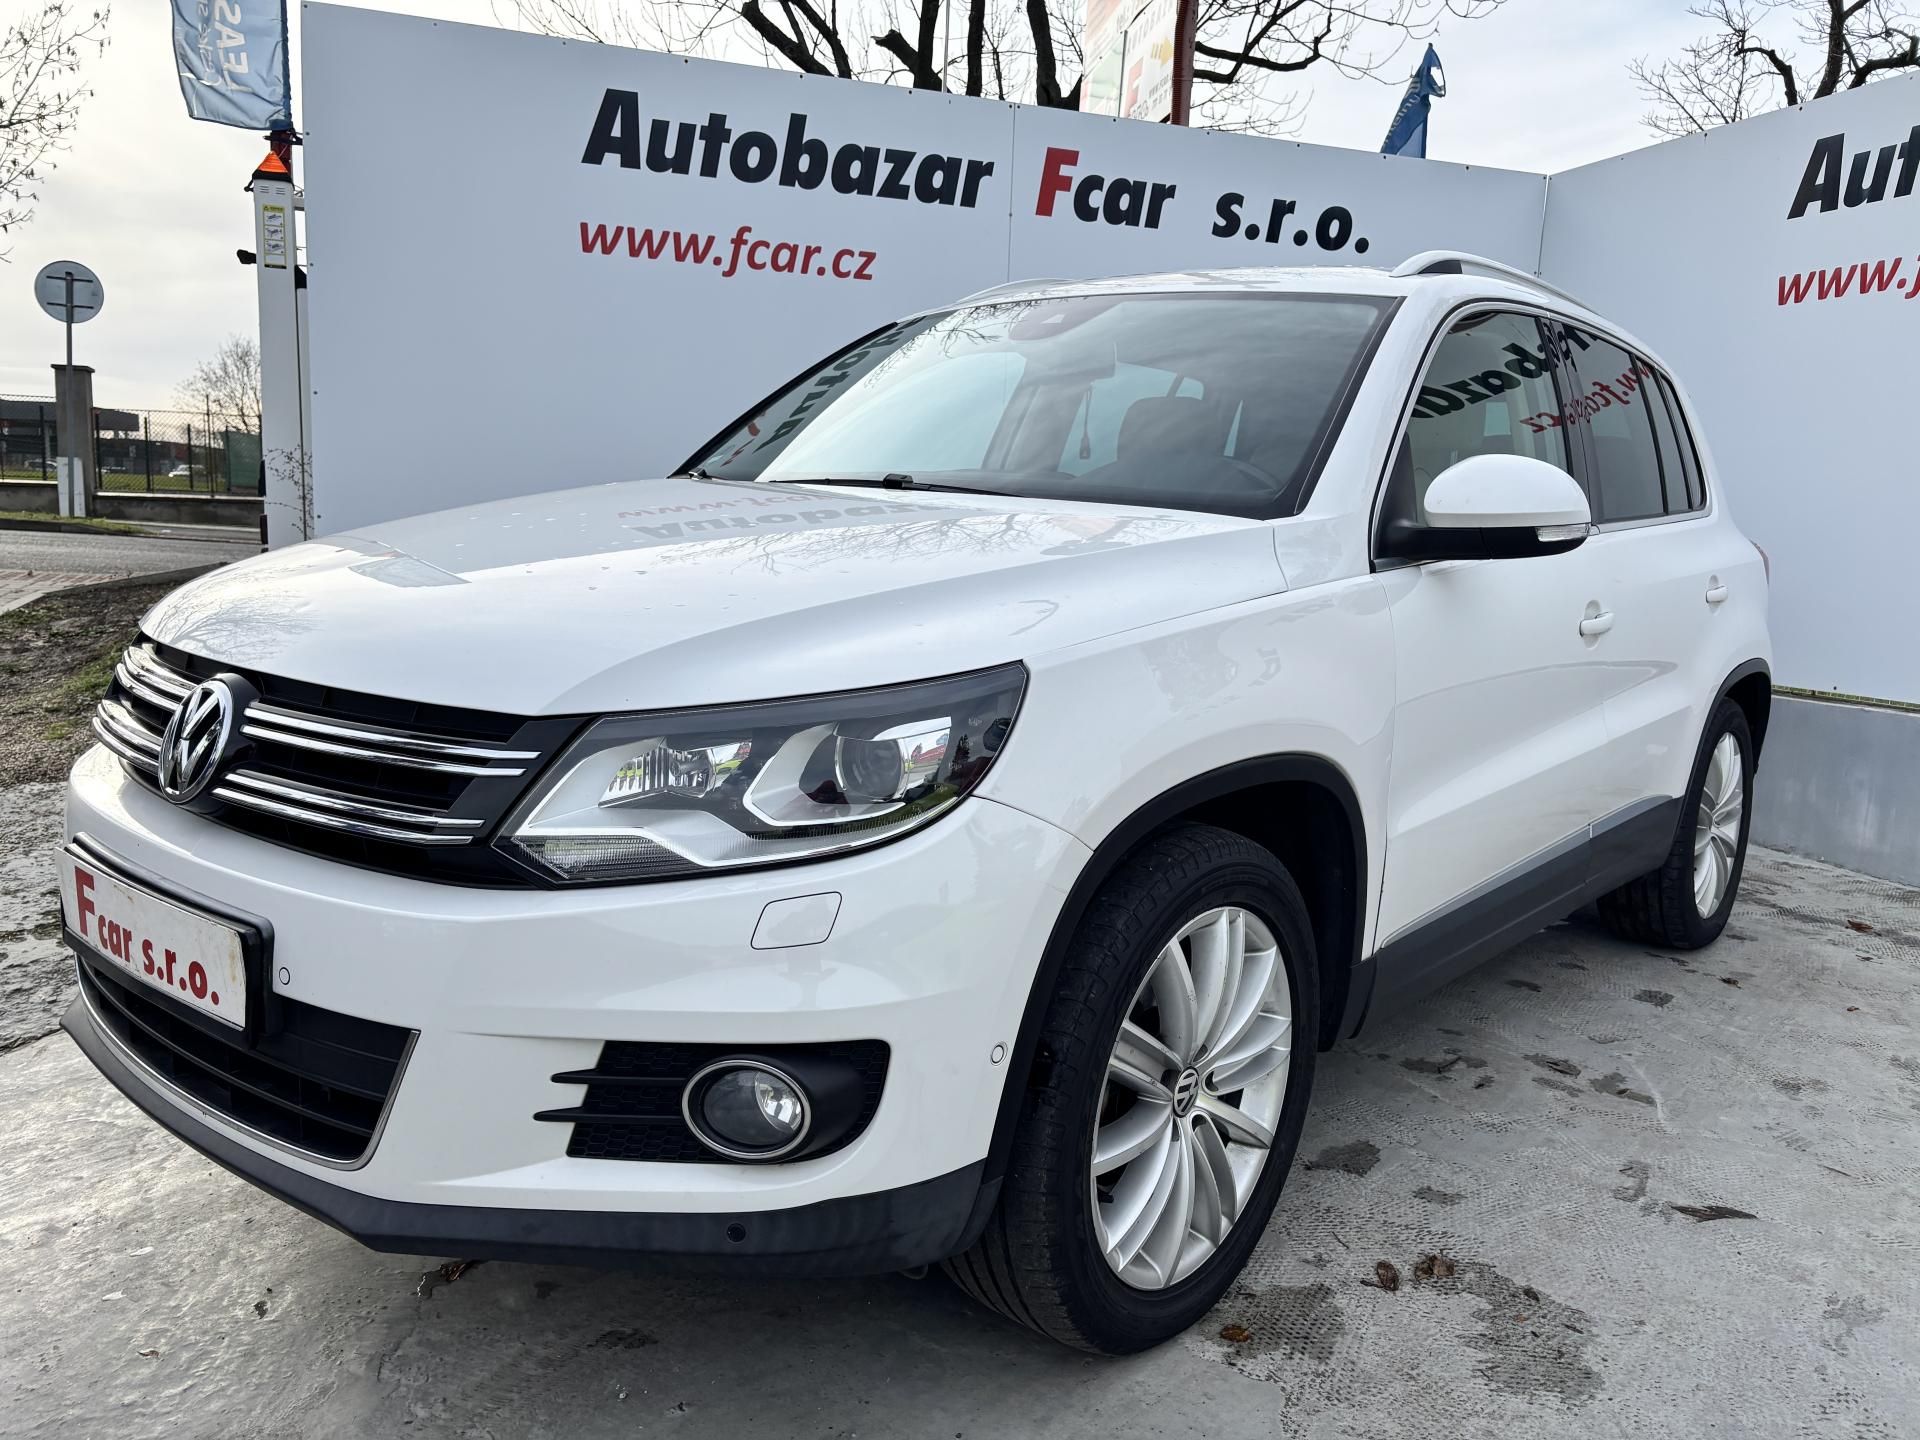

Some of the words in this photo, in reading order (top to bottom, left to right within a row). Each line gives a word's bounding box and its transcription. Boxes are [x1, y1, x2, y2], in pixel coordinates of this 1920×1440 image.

[580, 87, 995, 208] Autobazar
[1035, 146, 1177, 229] Fcar
[1211, 192, 1370, 254] s.r.o.
[579, 221, 877, 281] www.fcar.cz
[141, 938, 221, 1006] s.r.o.
